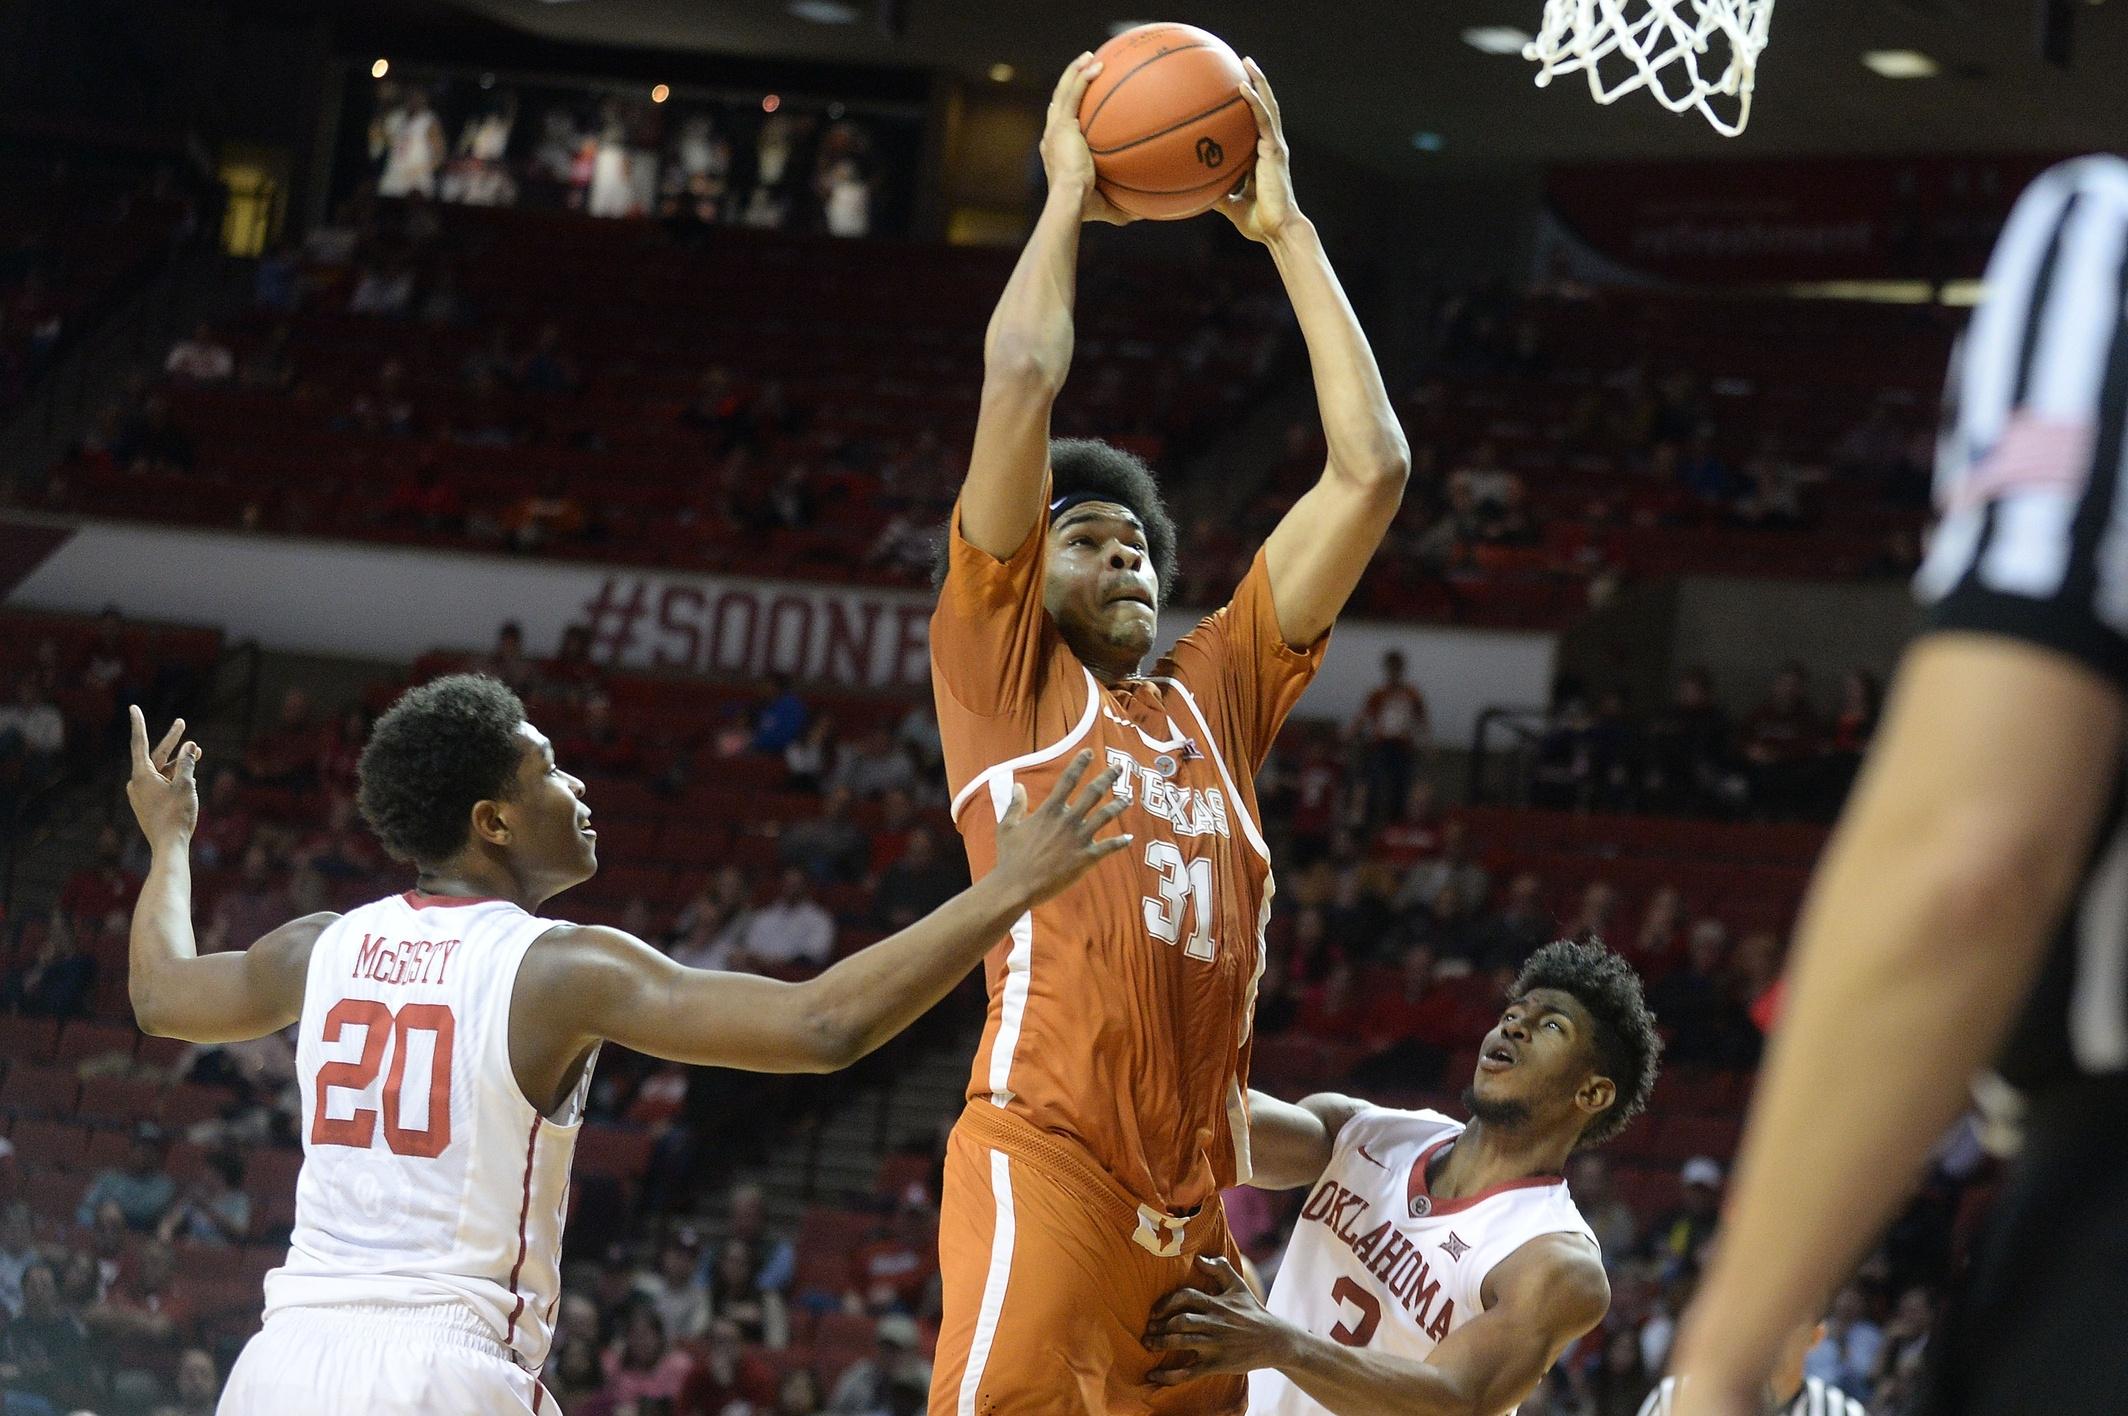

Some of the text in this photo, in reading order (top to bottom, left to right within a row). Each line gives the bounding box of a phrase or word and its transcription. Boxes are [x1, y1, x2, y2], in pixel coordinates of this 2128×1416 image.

[1105, 747, 1230, 838] TEXAS
[1142, 839, 1216, 963] 31
[311, 998, 456, 1159] 20
[1301, 1180, 1455, 1344] OKLAHOMA
